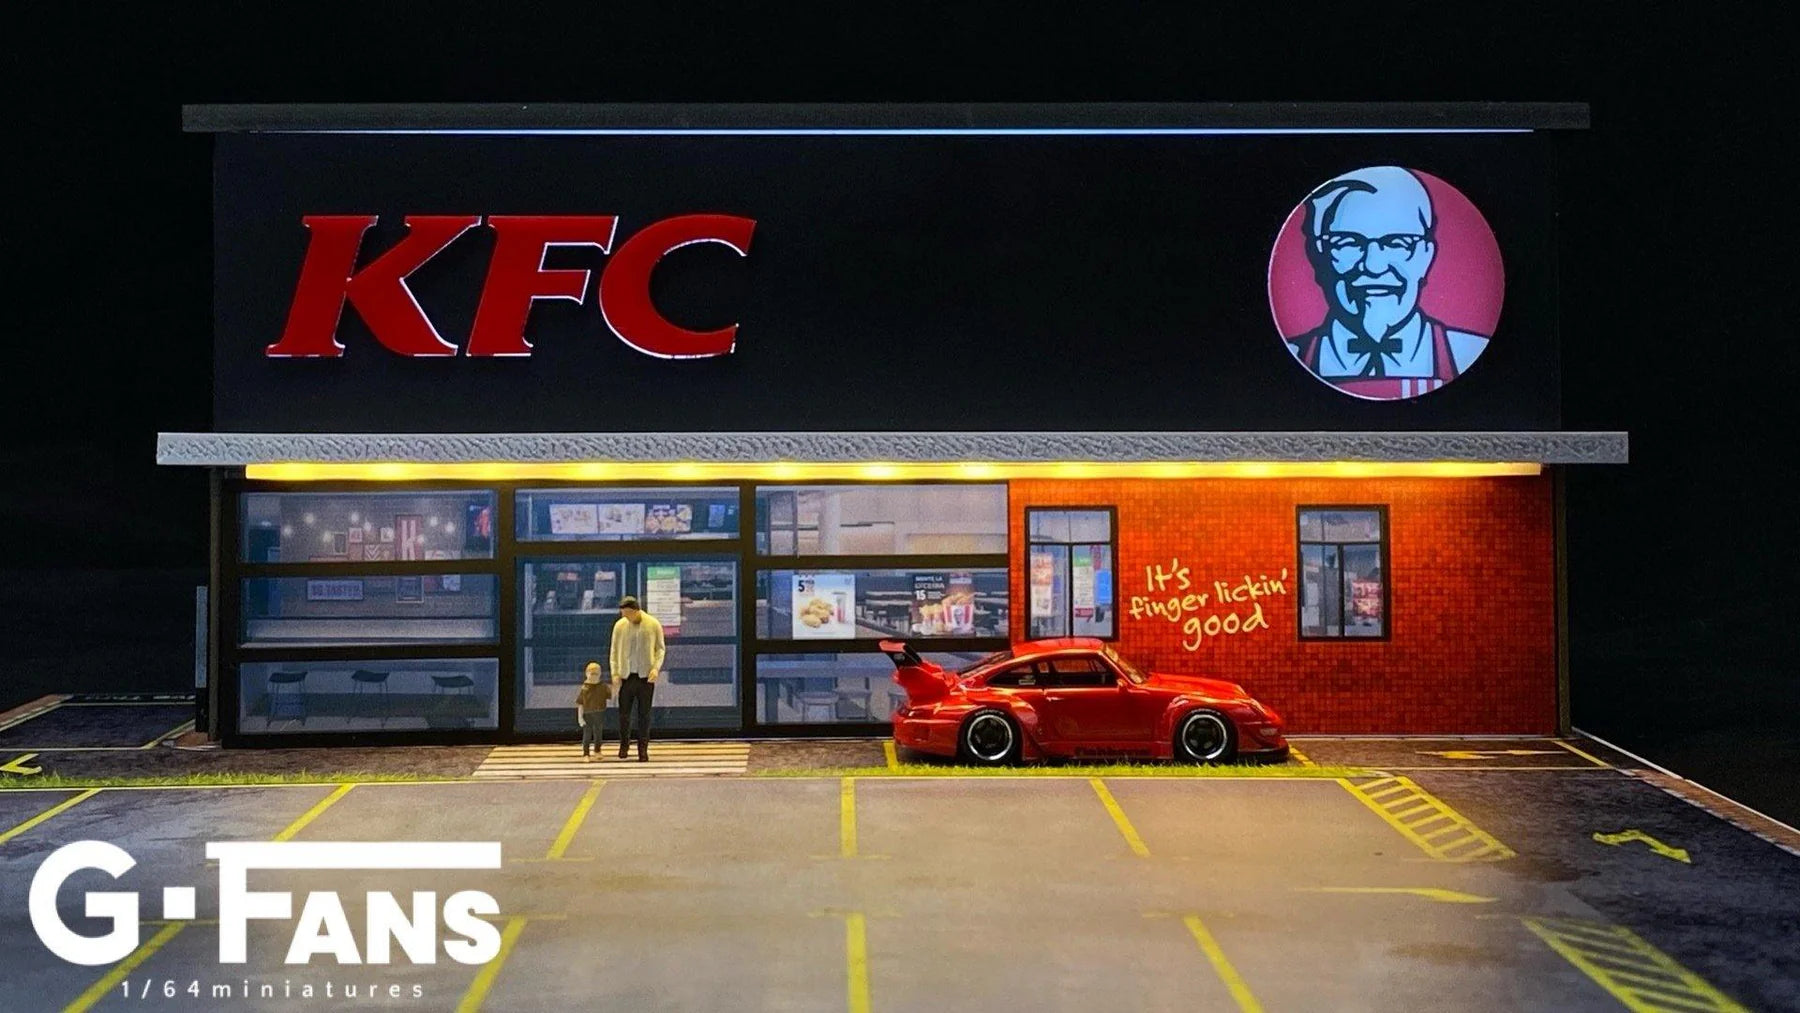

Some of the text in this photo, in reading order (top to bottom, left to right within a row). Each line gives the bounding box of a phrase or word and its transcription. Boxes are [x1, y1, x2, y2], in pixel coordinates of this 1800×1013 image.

[266, 213, 757, 360] KFC
[1128, 567, 1288, 623] finger lickin'
[1145, 557, 1191, 592] It's
[1182, 602, 1269, 651] good
